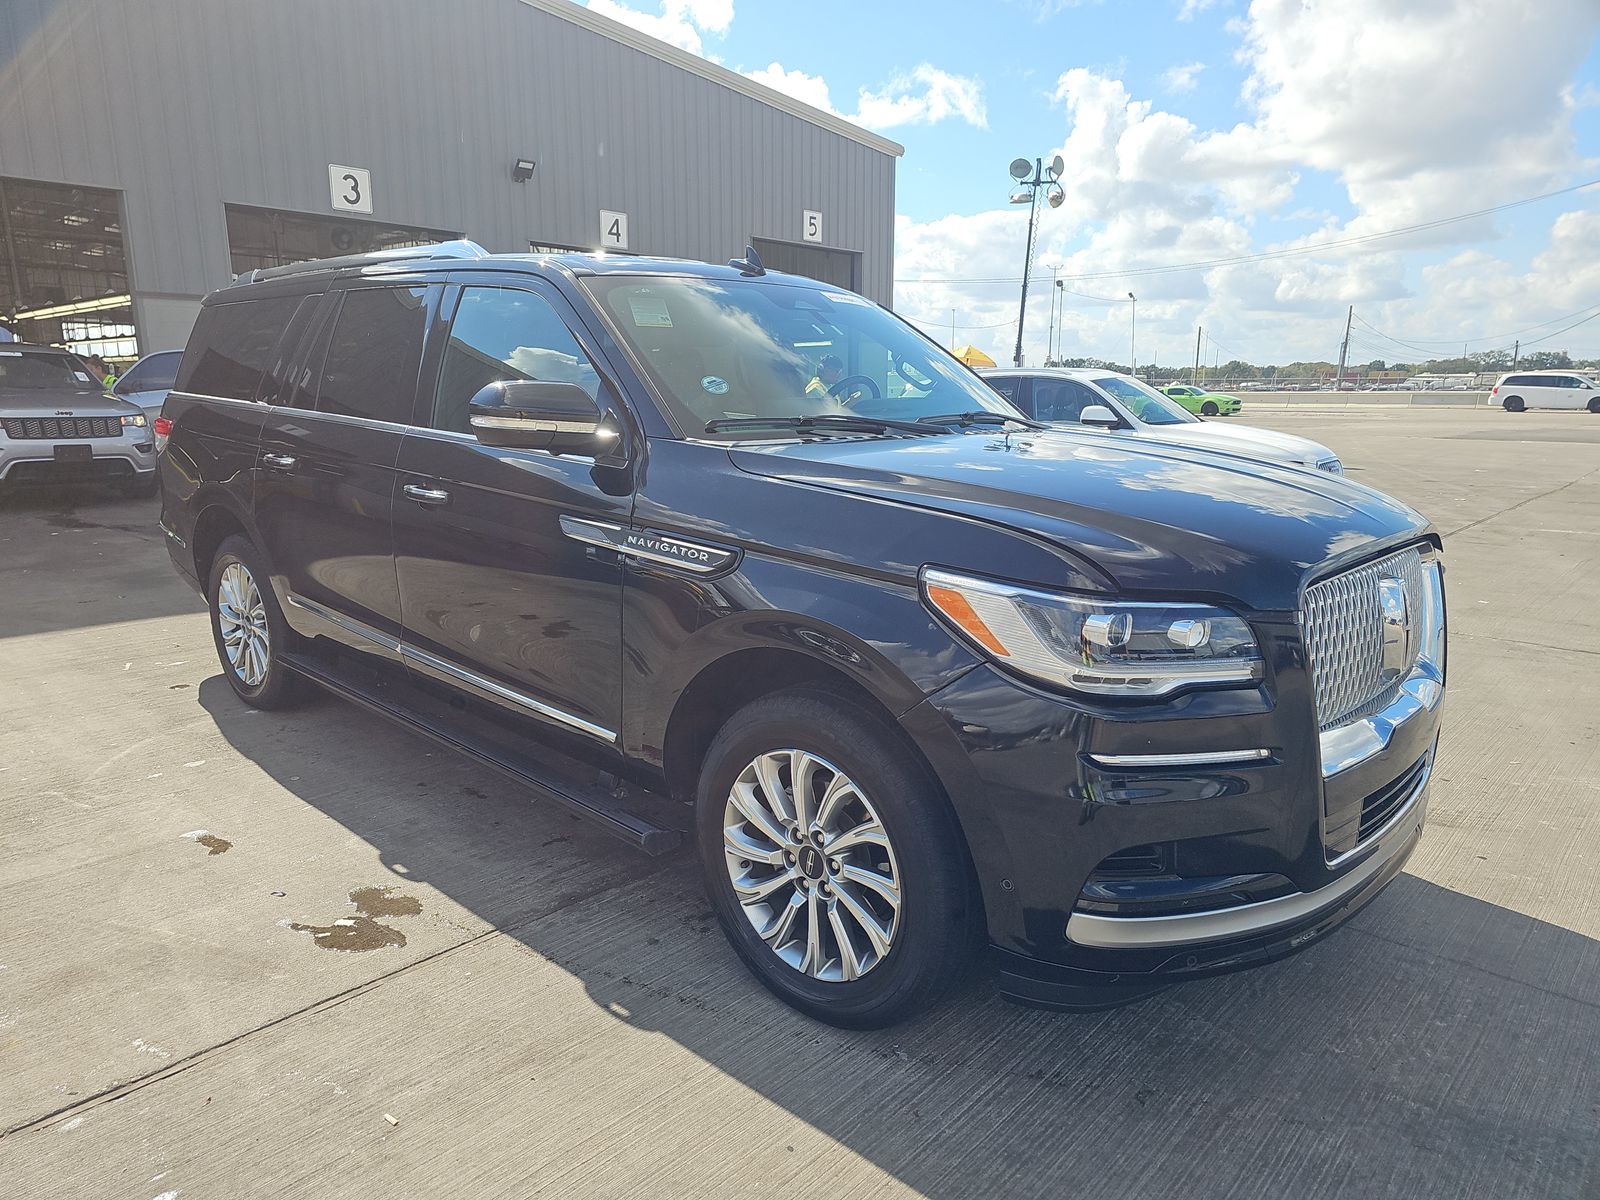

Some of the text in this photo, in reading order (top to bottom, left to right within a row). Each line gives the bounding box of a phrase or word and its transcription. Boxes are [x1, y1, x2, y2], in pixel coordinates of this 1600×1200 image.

[342, 174, 361, 205] 3
[608, 218, 622, 243] 4
[809, 216, 818, 237] 5
[627, 535, 709, 562] NAVIGATOR
